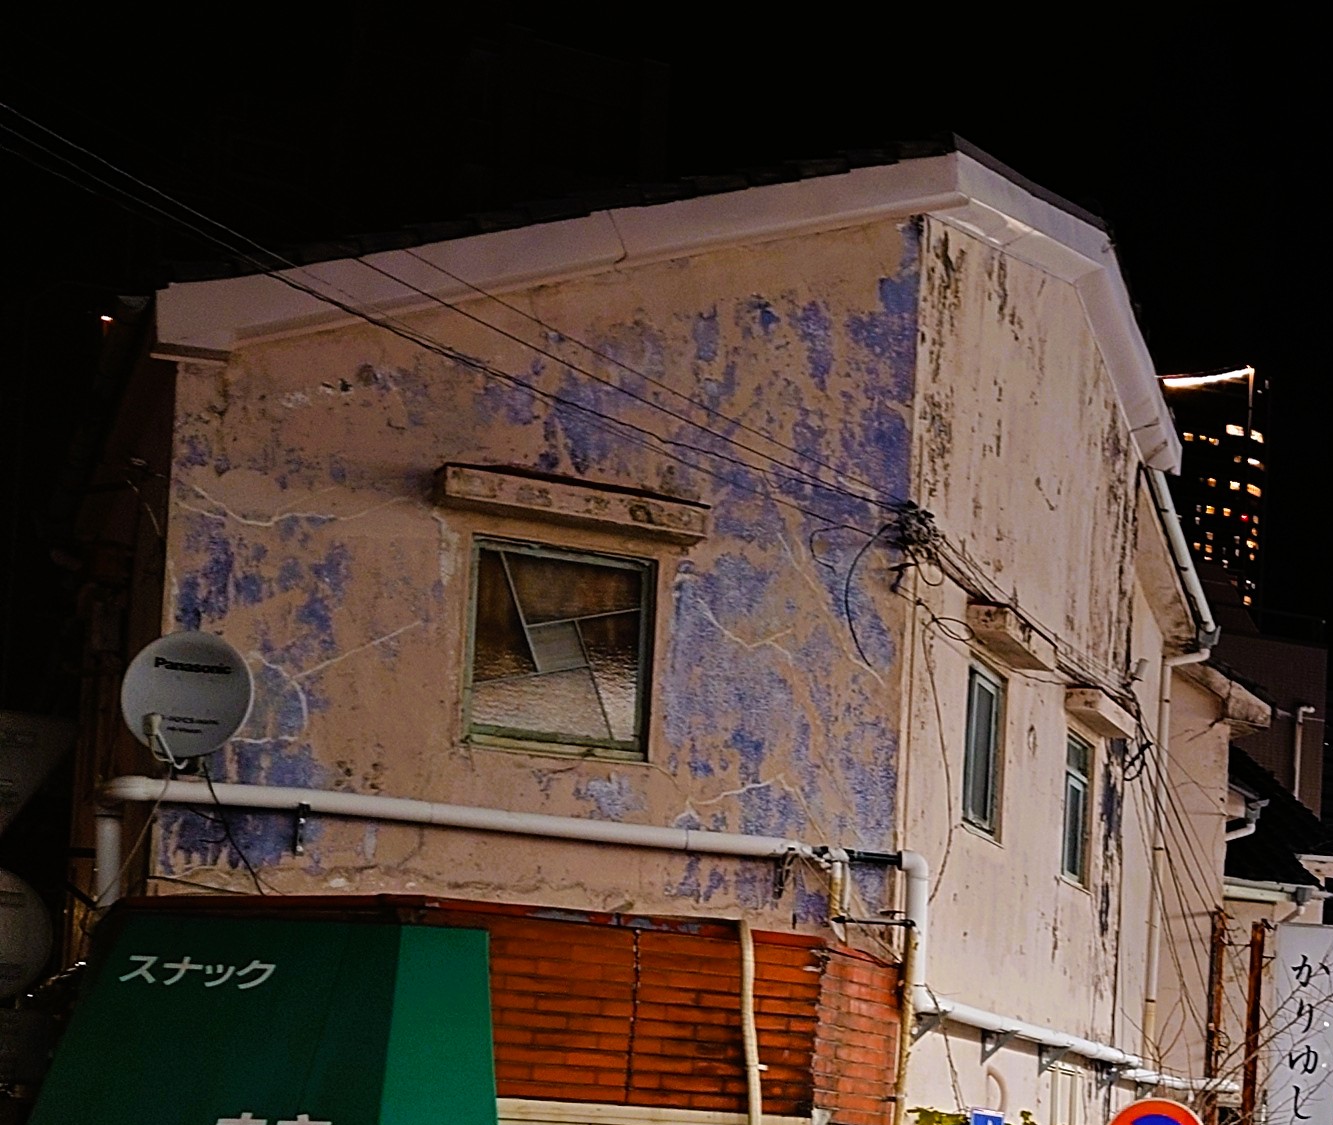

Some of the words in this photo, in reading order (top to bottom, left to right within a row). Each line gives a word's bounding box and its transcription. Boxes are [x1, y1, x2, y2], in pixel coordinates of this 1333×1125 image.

[154, 656, 233, 675] Panasonic
[119, 955, 277, 990] スナック
[1289, 955, 1330, 1120] かりゆし
